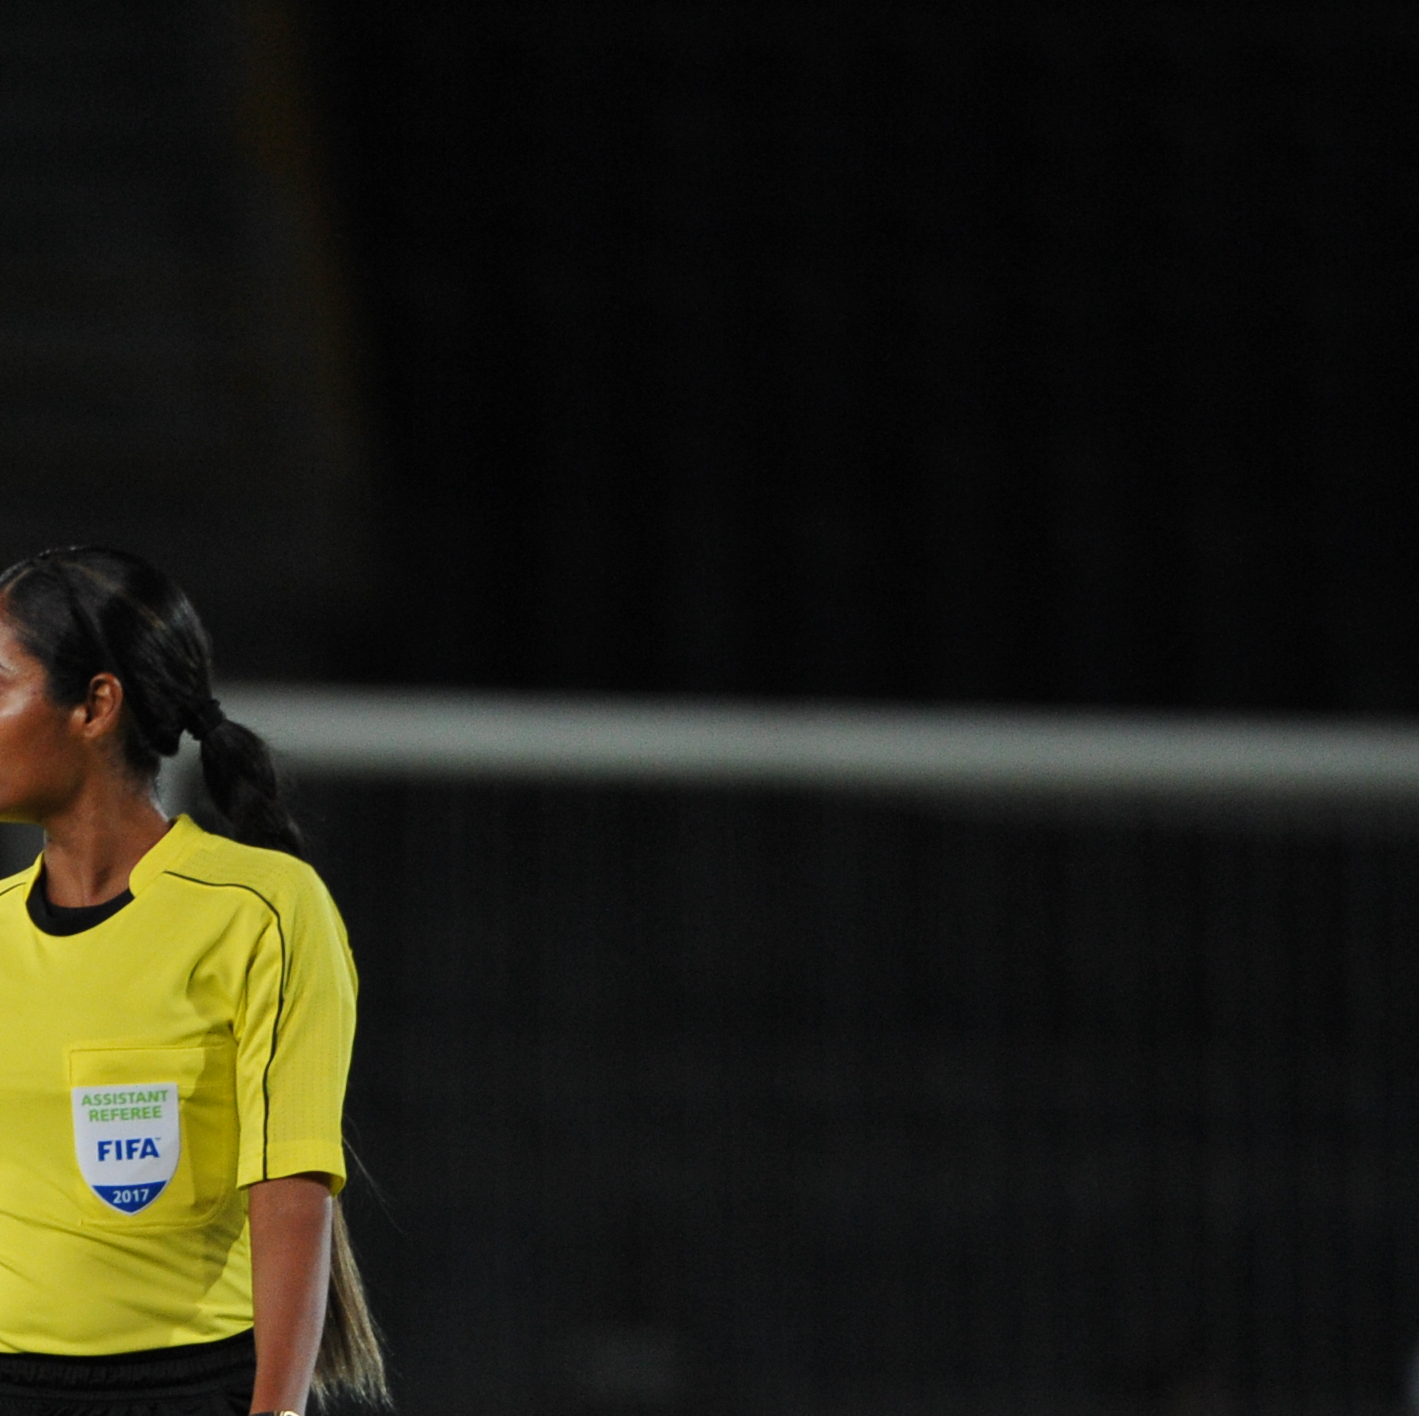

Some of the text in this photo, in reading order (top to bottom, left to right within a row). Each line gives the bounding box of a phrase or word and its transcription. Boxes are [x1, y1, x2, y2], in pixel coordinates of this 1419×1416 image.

[82, 1089, 169, 1107] ASSISTANT
[88, 1105, 163, 1122] REFEREE
[97, 1137, 161, 1162] FIFA
[112, 1188, 150, 1205] 2017
